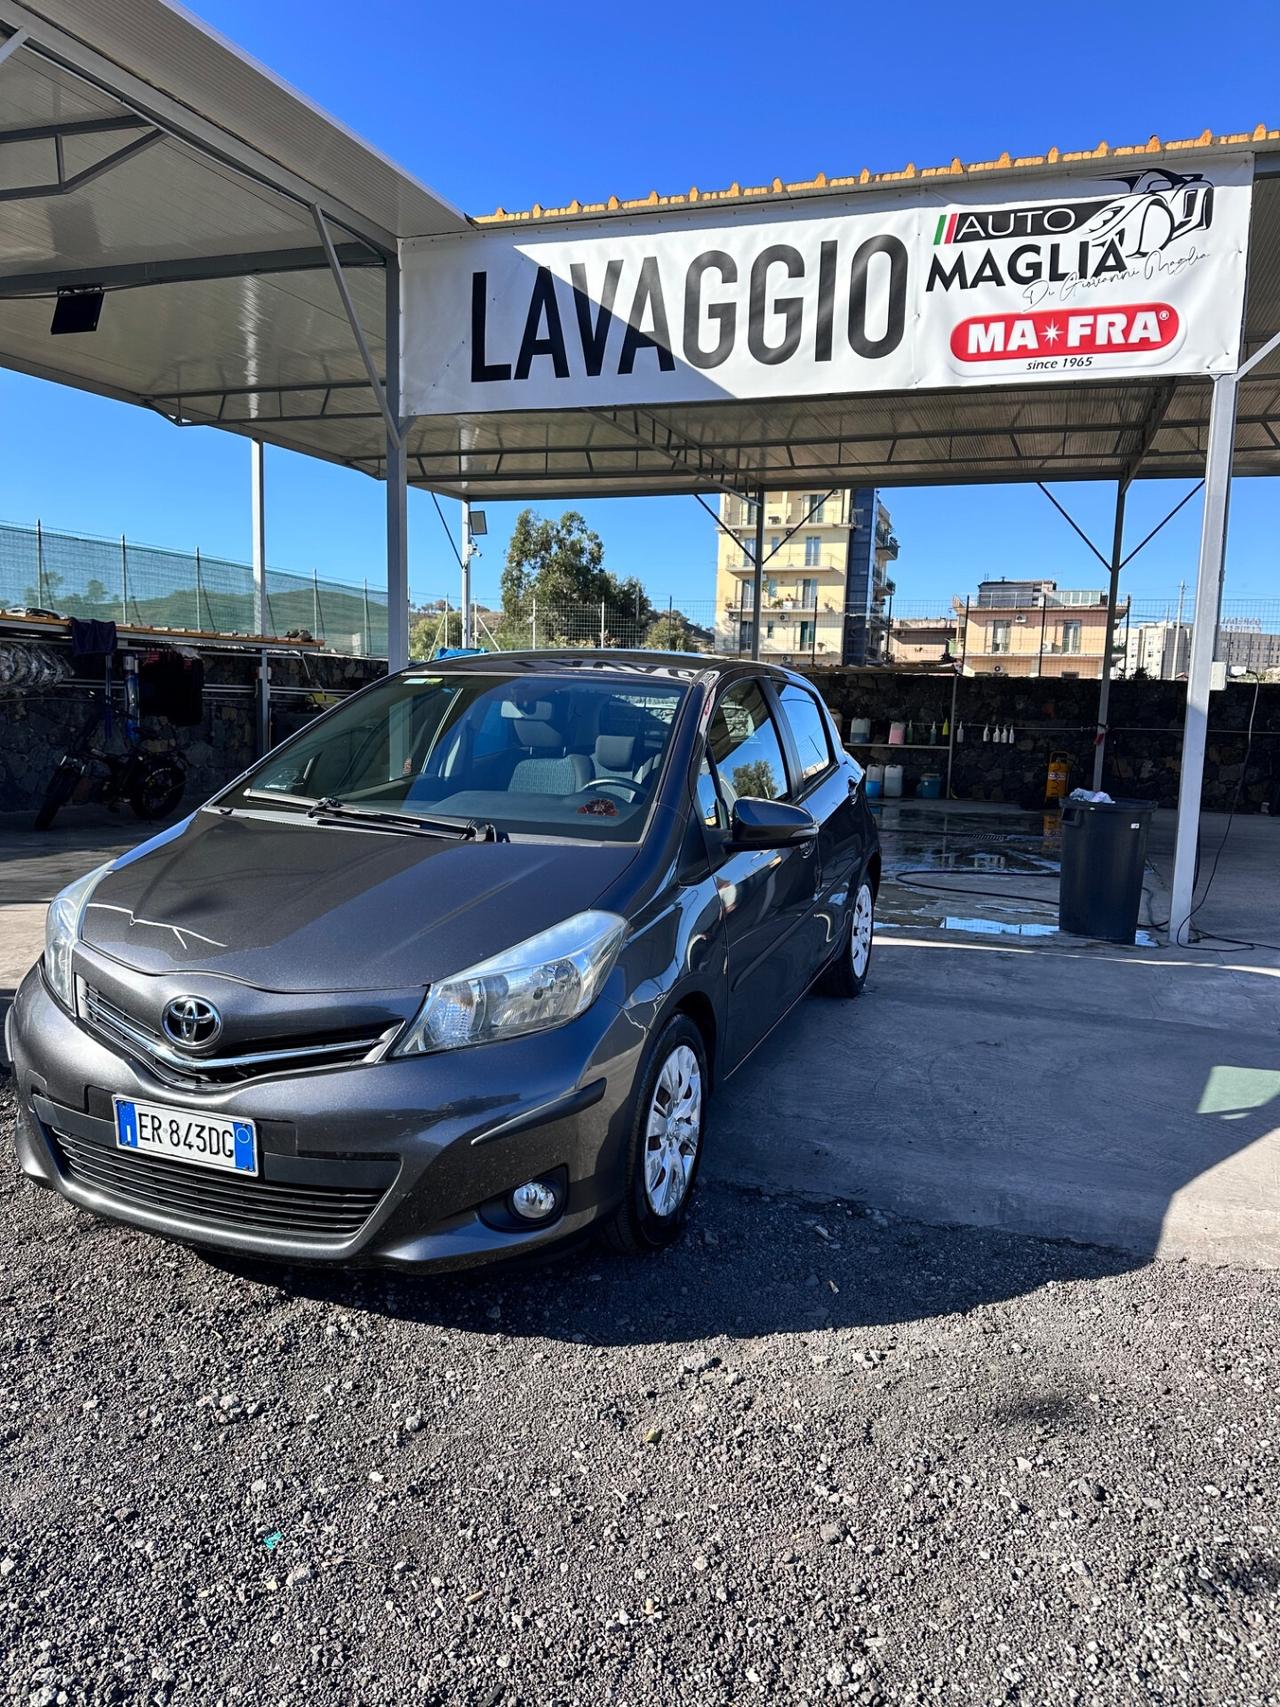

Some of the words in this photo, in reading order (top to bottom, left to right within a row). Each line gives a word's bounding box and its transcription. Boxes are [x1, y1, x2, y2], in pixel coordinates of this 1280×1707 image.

[956, 208, 1076, 240] AUTO
[926, 237, 1128, 292] MAGLIA
[1060, 268, 1140, 301] Giovanni
[1144, 246, 1211, 279] Maglia
[471, 234, 909, 383] LAVAGGIO
[1026, 358, 1058, 371] since
[1062, 355, 1093, 369] 1965
[138, 1112, 163, 1144] ER
[169, 1119, 234, 1159] 843DG
